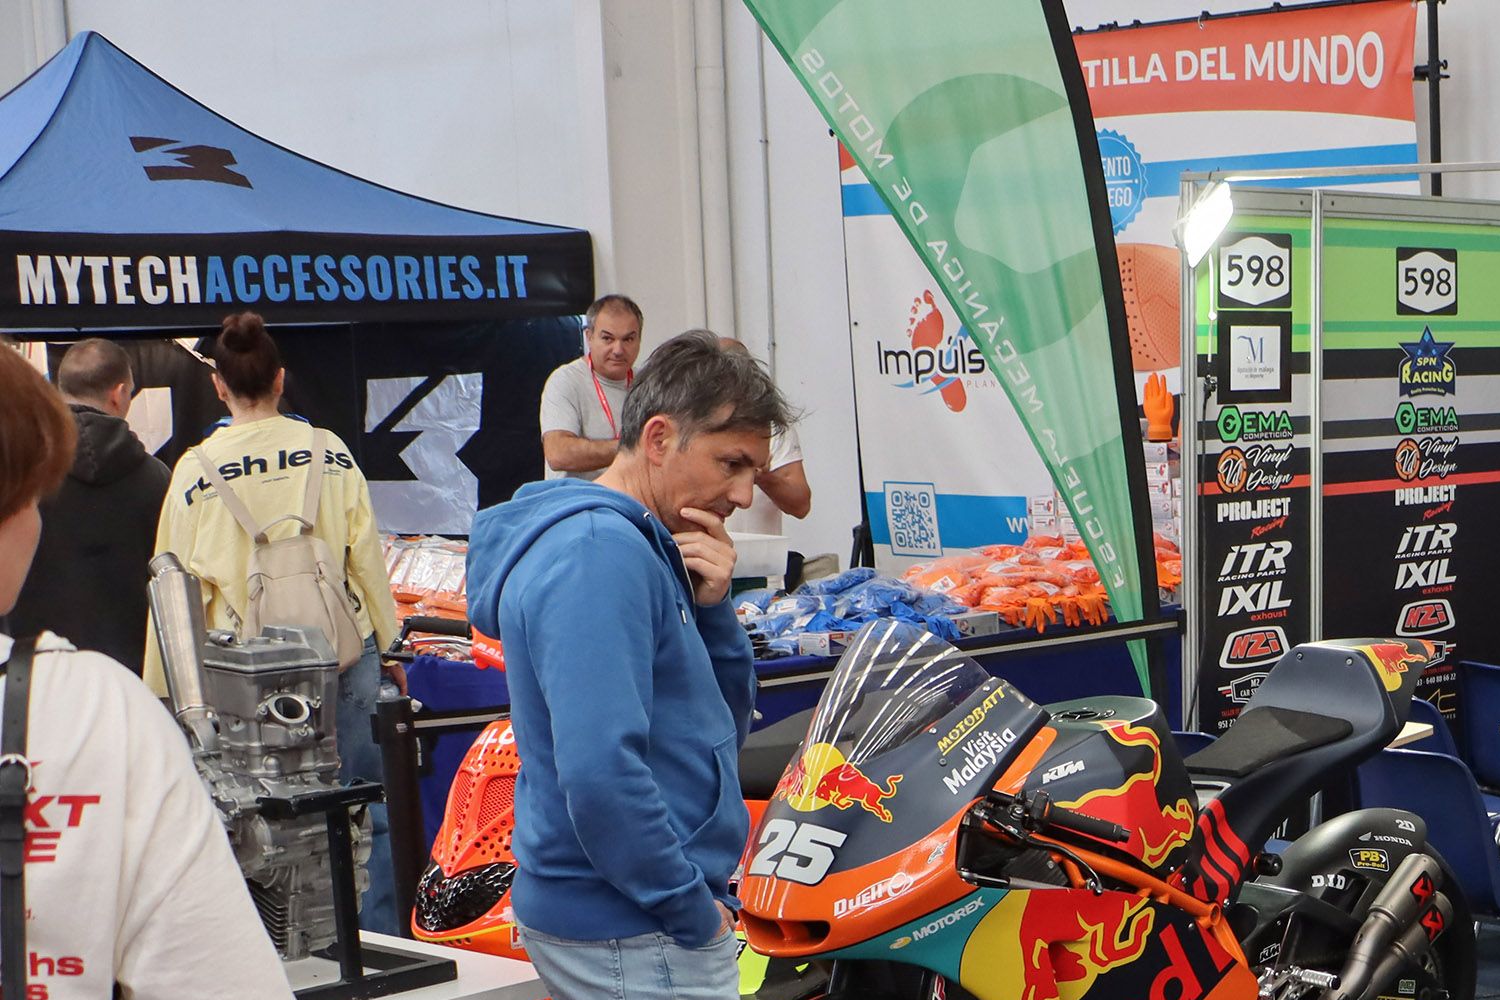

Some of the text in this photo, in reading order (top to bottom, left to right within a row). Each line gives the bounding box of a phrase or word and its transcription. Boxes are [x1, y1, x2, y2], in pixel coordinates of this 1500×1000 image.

[1175, 46, 1236, 81] DEL
[1244, 31, 1385, 89] MUNDO
[17, 253, 530, 305] MYTECHACCESSORIES.IT
[1227, 255, 1285, 287] 598
[1404, 268, 1452, 297] 598
[1401, 361, 1454, 384] RACING
[1416, 357, 1437, 367] SPN
[1243, 411, 1293, 433] EMA
[1417, 407, 1458, 426] EMA
[1246, 446, 1293, 469] Vinyl
[1420, 439, 1458, 459] Vinyl
[1420, 458, 1458, 479] Design
[1246, 468, 1293, 492] Design
[1395, 484, 1457, 506] PROJECT
[1217, 497, 1291, 523] PROJECT
[1395, 548, 1453, 560] RACING PARTS
[1217, 569, 1287, 583] RACING PARTS
[1395, 559, 1457, 590] IXIL
[1217, 580, 1292, 617] IXIL
[1422, 585, 1453, 595] exhaust
[1250, 609, 1288, 622] exhaust
[937, 686, 1006, 753] MOTOBATT
[1218, 719, 1228, 729] 951
[942, 727, 1017, 795] Malaysia
[1042, 760, 1086, 785] KTM
[1395, 819, 1416, 833] 2D
[1374, 835, 1413, 847] HONDA
[748, 818, 848, 887] 25
[1359, 850, 1381, 863] PB
[1356, 861, 1386, 870] Pro-Bolt
[912, 896, 985, 941] MOTOREX
